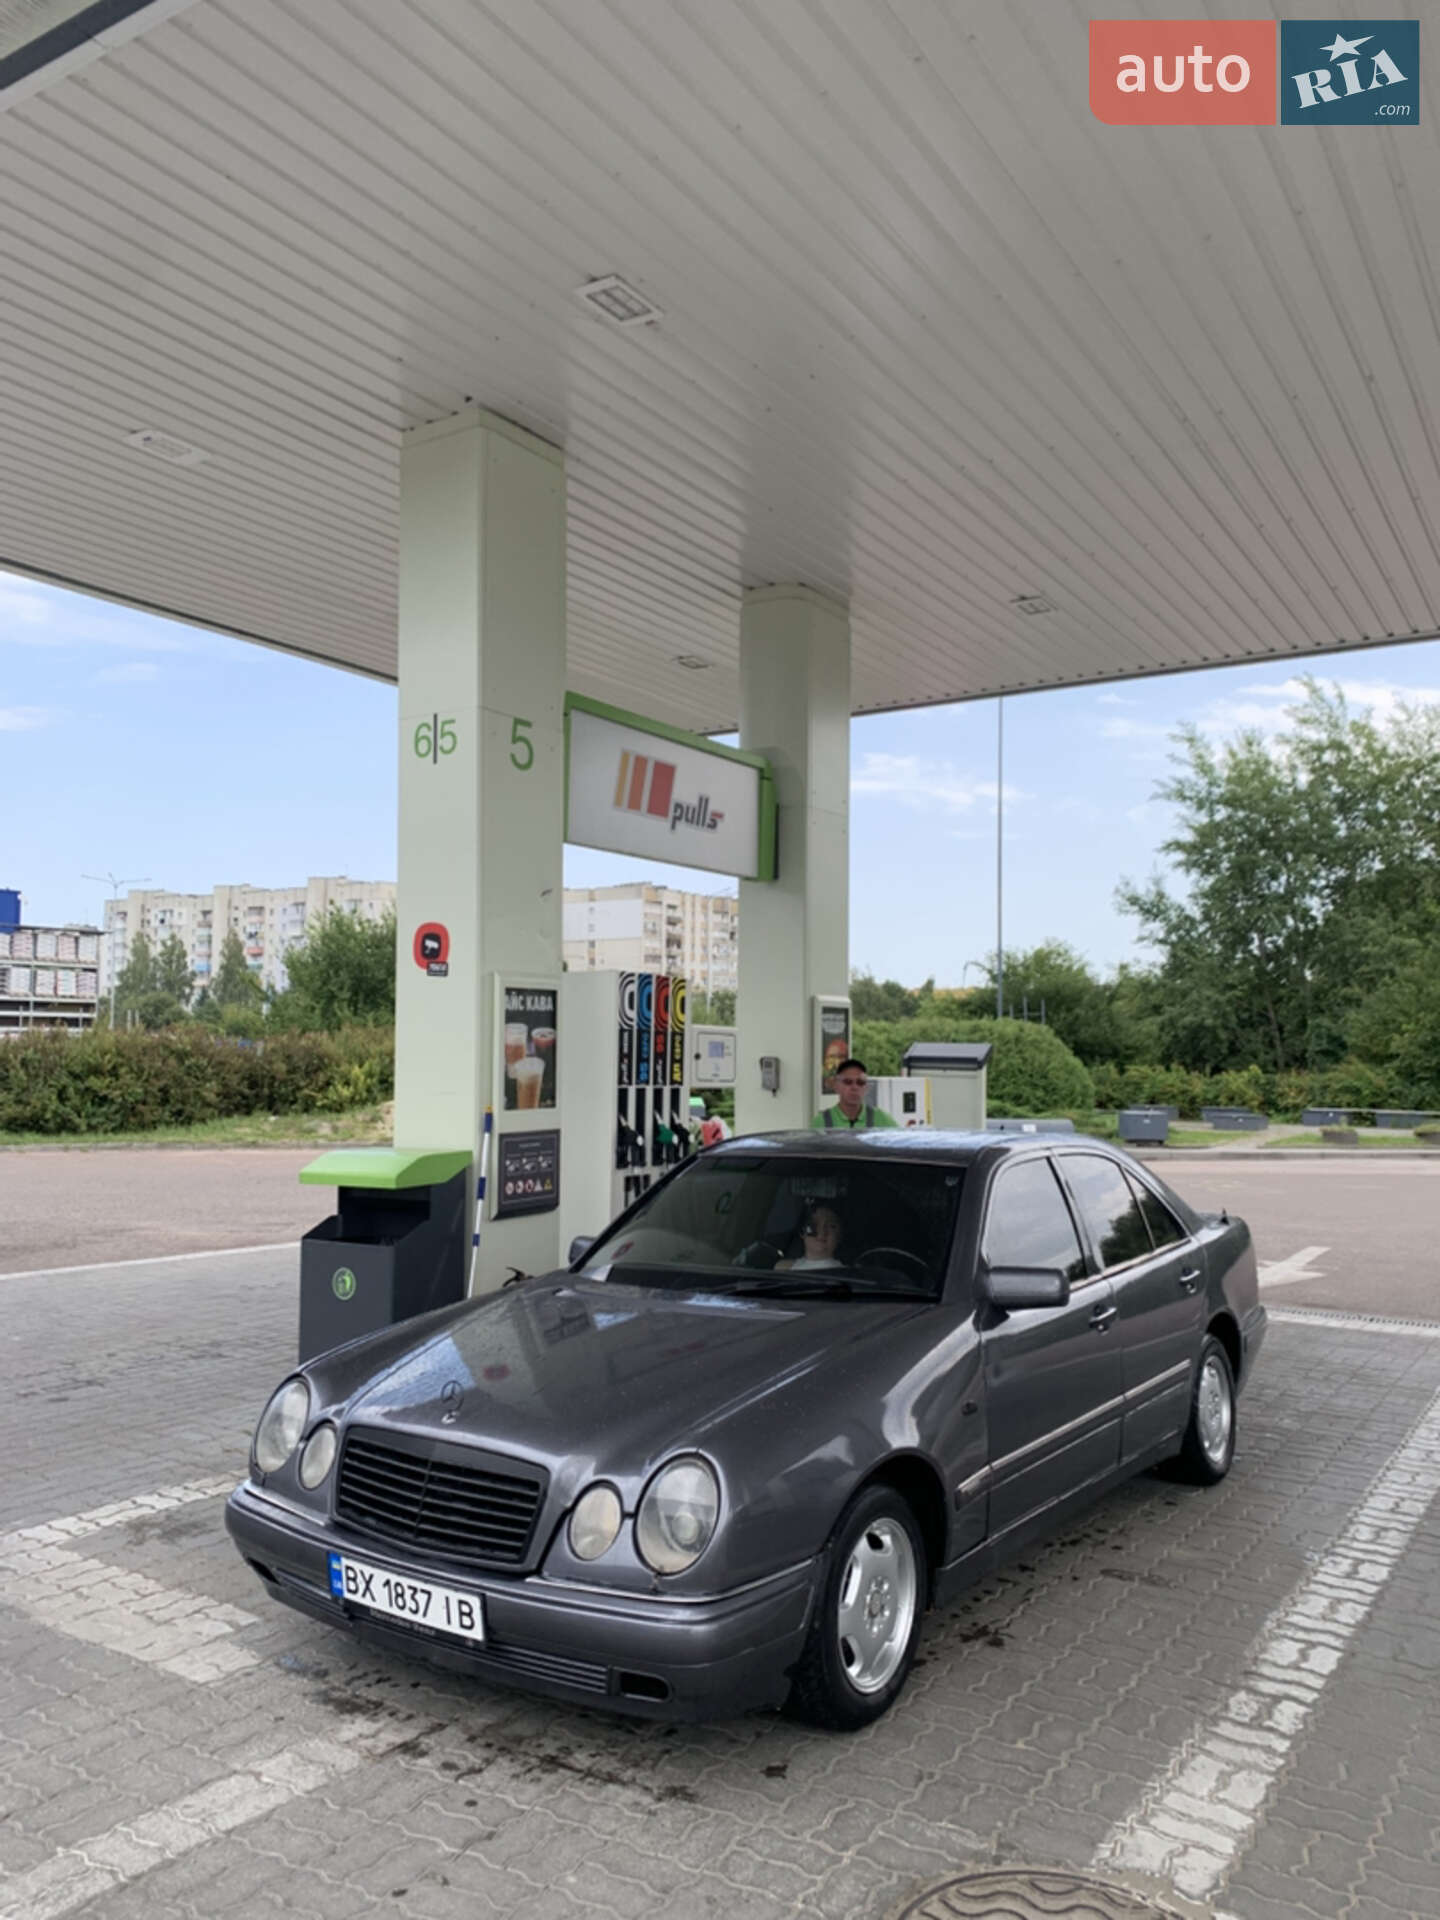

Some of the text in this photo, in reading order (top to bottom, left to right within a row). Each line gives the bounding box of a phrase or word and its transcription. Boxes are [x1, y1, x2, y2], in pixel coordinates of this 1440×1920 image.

[509, 717, 534, 771] 5
[670, 795, 725, 831] pulls
[344, 1565, 376, 1603] BX
[382, 1578, 432, 1619] 1837
[445, 1595, 475, 1631] IB
